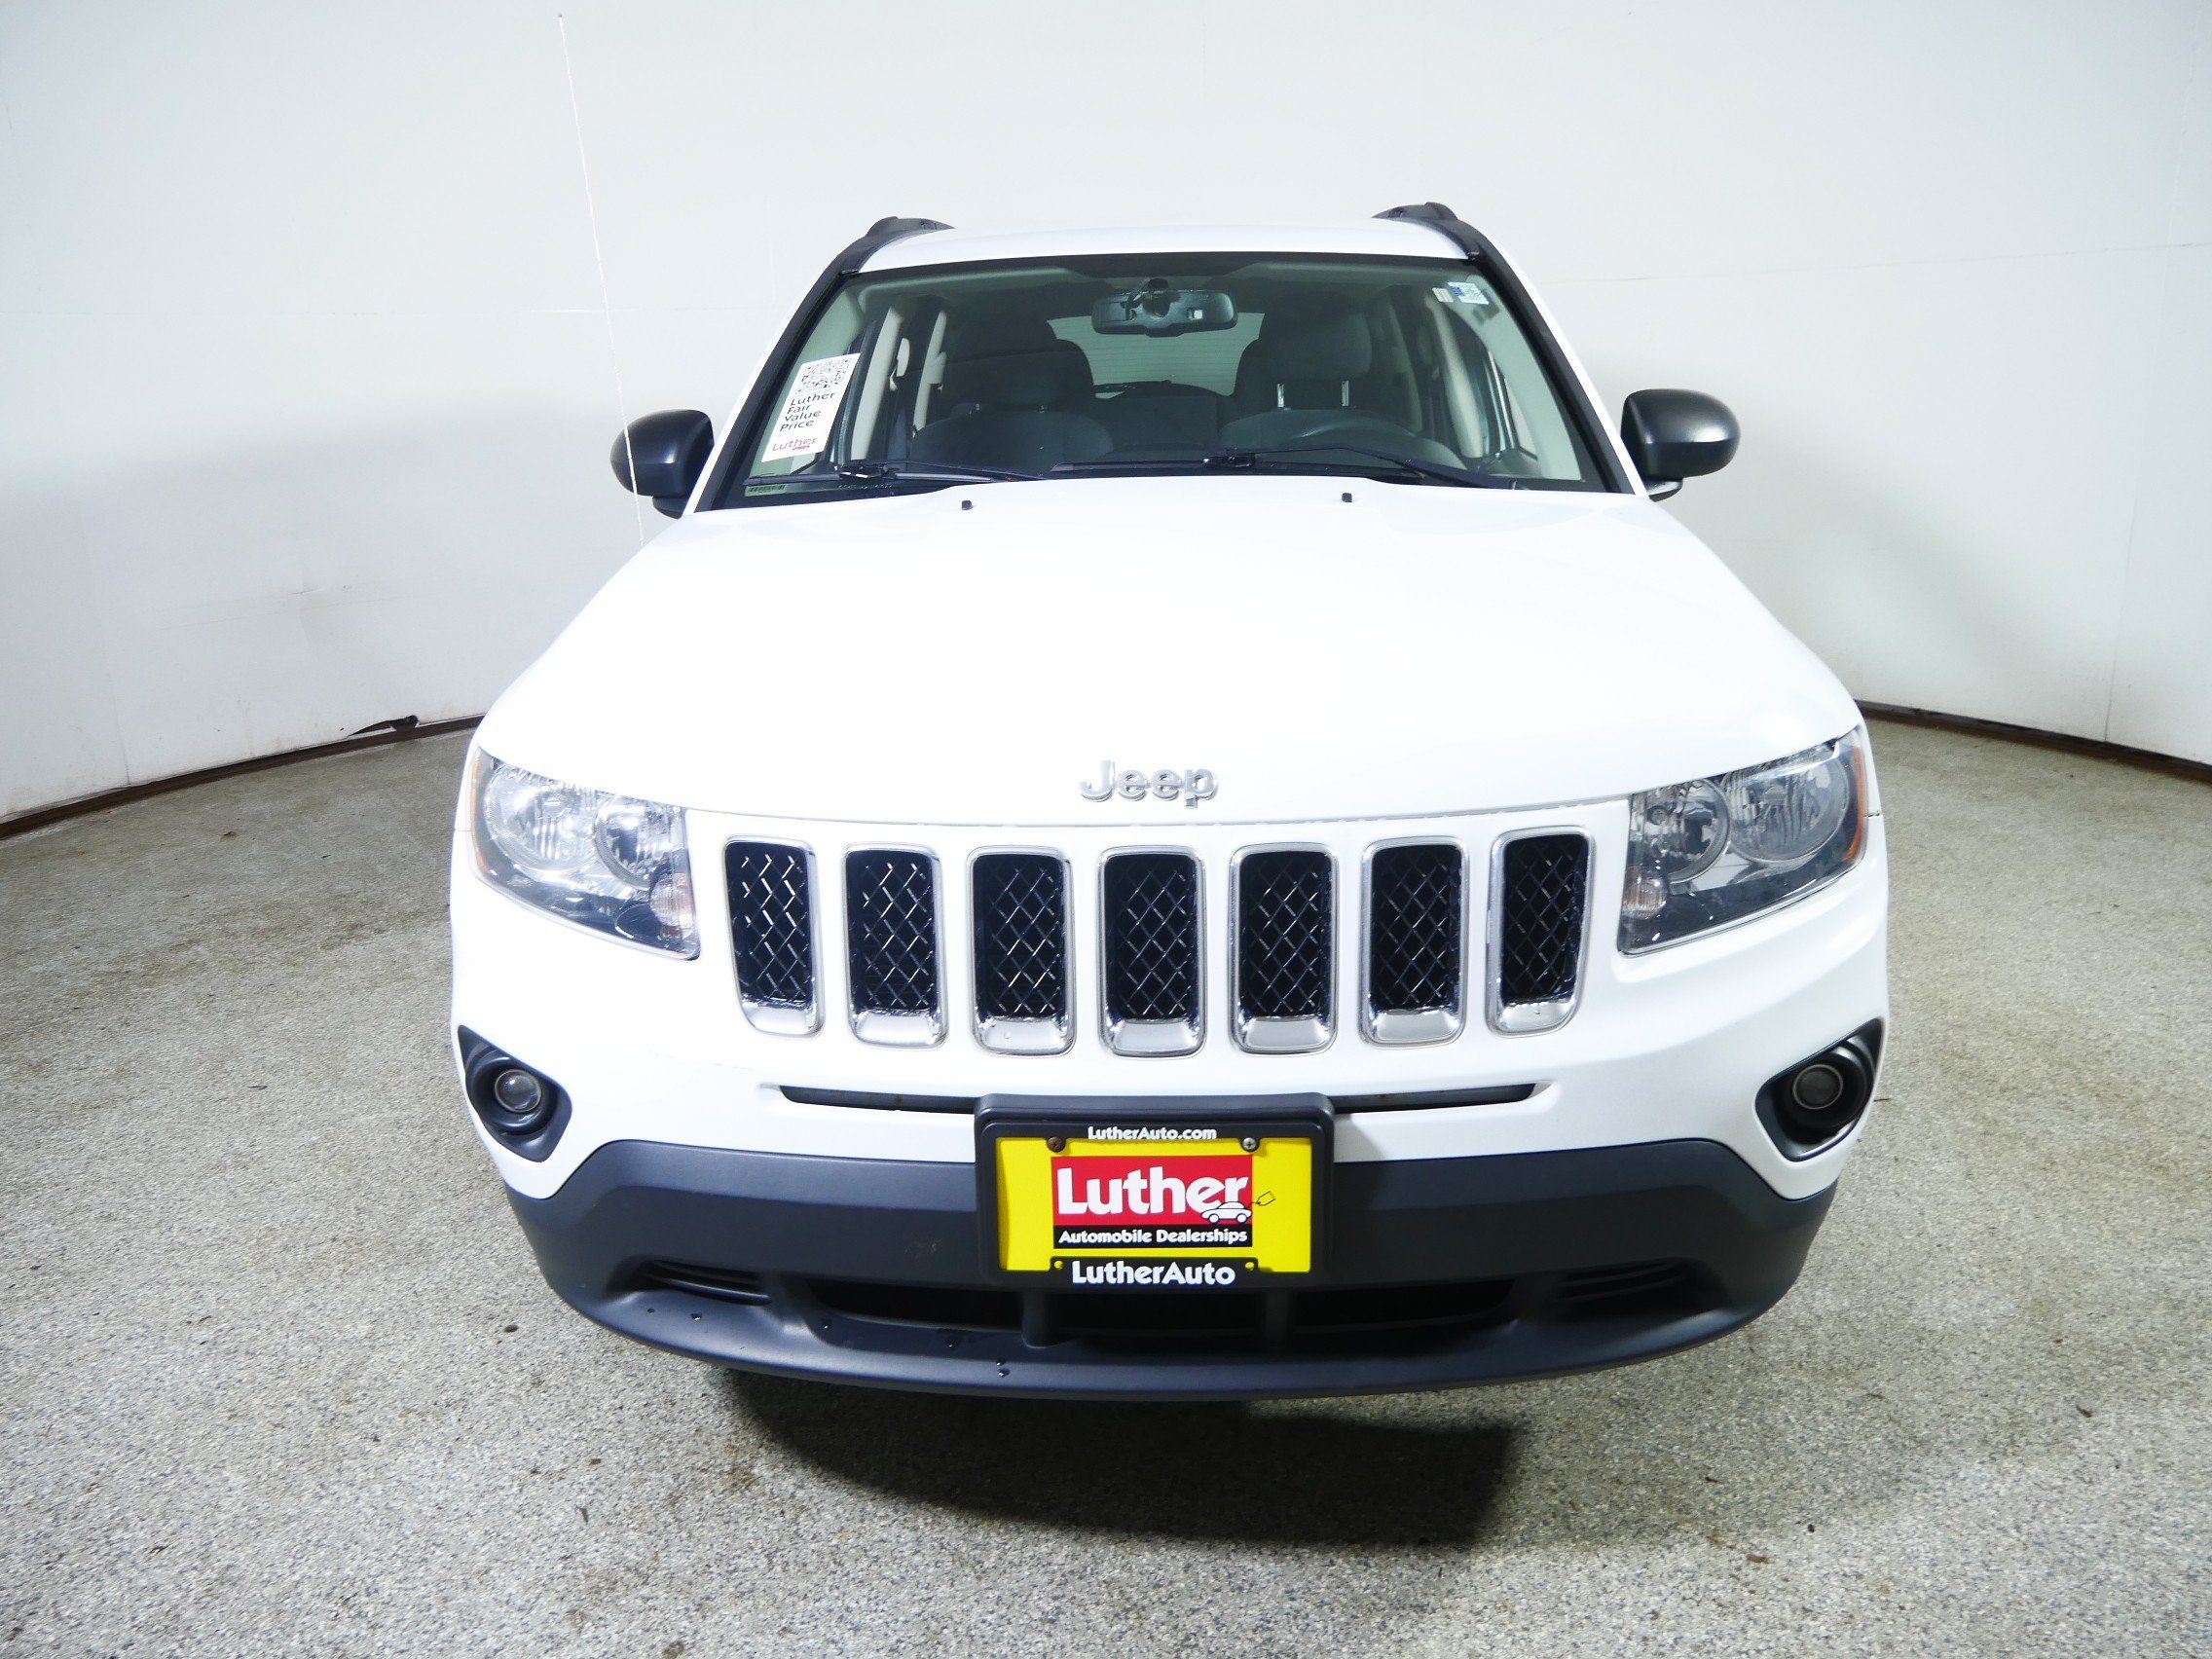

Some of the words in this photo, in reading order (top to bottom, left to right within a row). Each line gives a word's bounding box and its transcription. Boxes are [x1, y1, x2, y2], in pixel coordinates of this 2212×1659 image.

[791, 392, 835, 406] Luther
[1079, 759, 1219, 809] Jeep
[1088, 1125, 1217, 1141] LutherAuto.com
[1056, 1165, 1249, 1215] Luther
[1058, 1229, 1153, 1245] Automobile
[1156, 1228, 1248, 1245] Dealerships
[1072, 1260, 1236, 1286] LutherAuto
